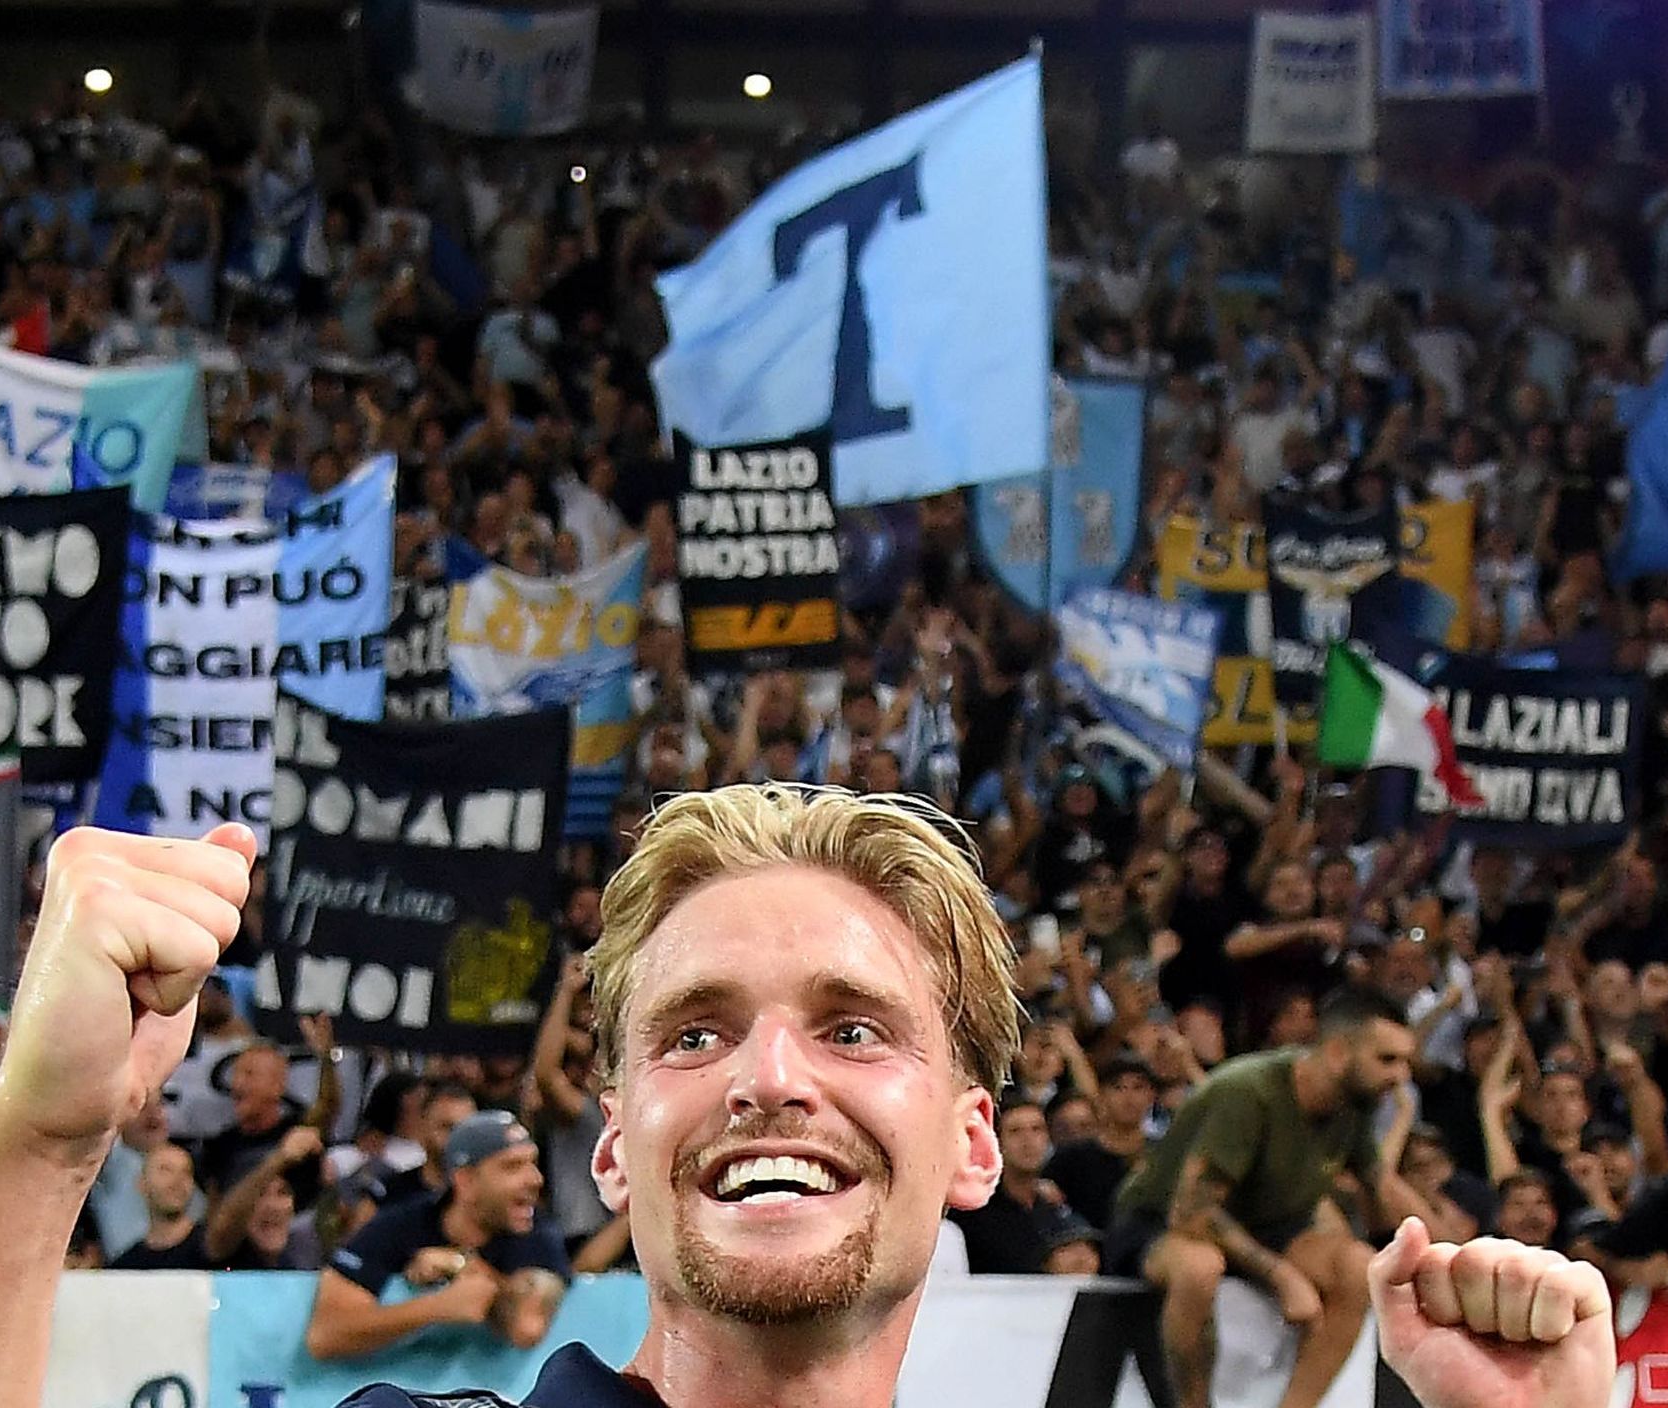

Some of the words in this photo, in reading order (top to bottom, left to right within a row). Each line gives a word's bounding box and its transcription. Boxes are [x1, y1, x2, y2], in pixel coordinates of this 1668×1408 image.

[774, 147, 928, 446] T
[690, 446, 819, 491] LAZIO
[678, 488, 836, 536] PATRIA
[678, 532, 840, 581] NOSTRA
[1451, 685, 1630, 754] LAZIALI
